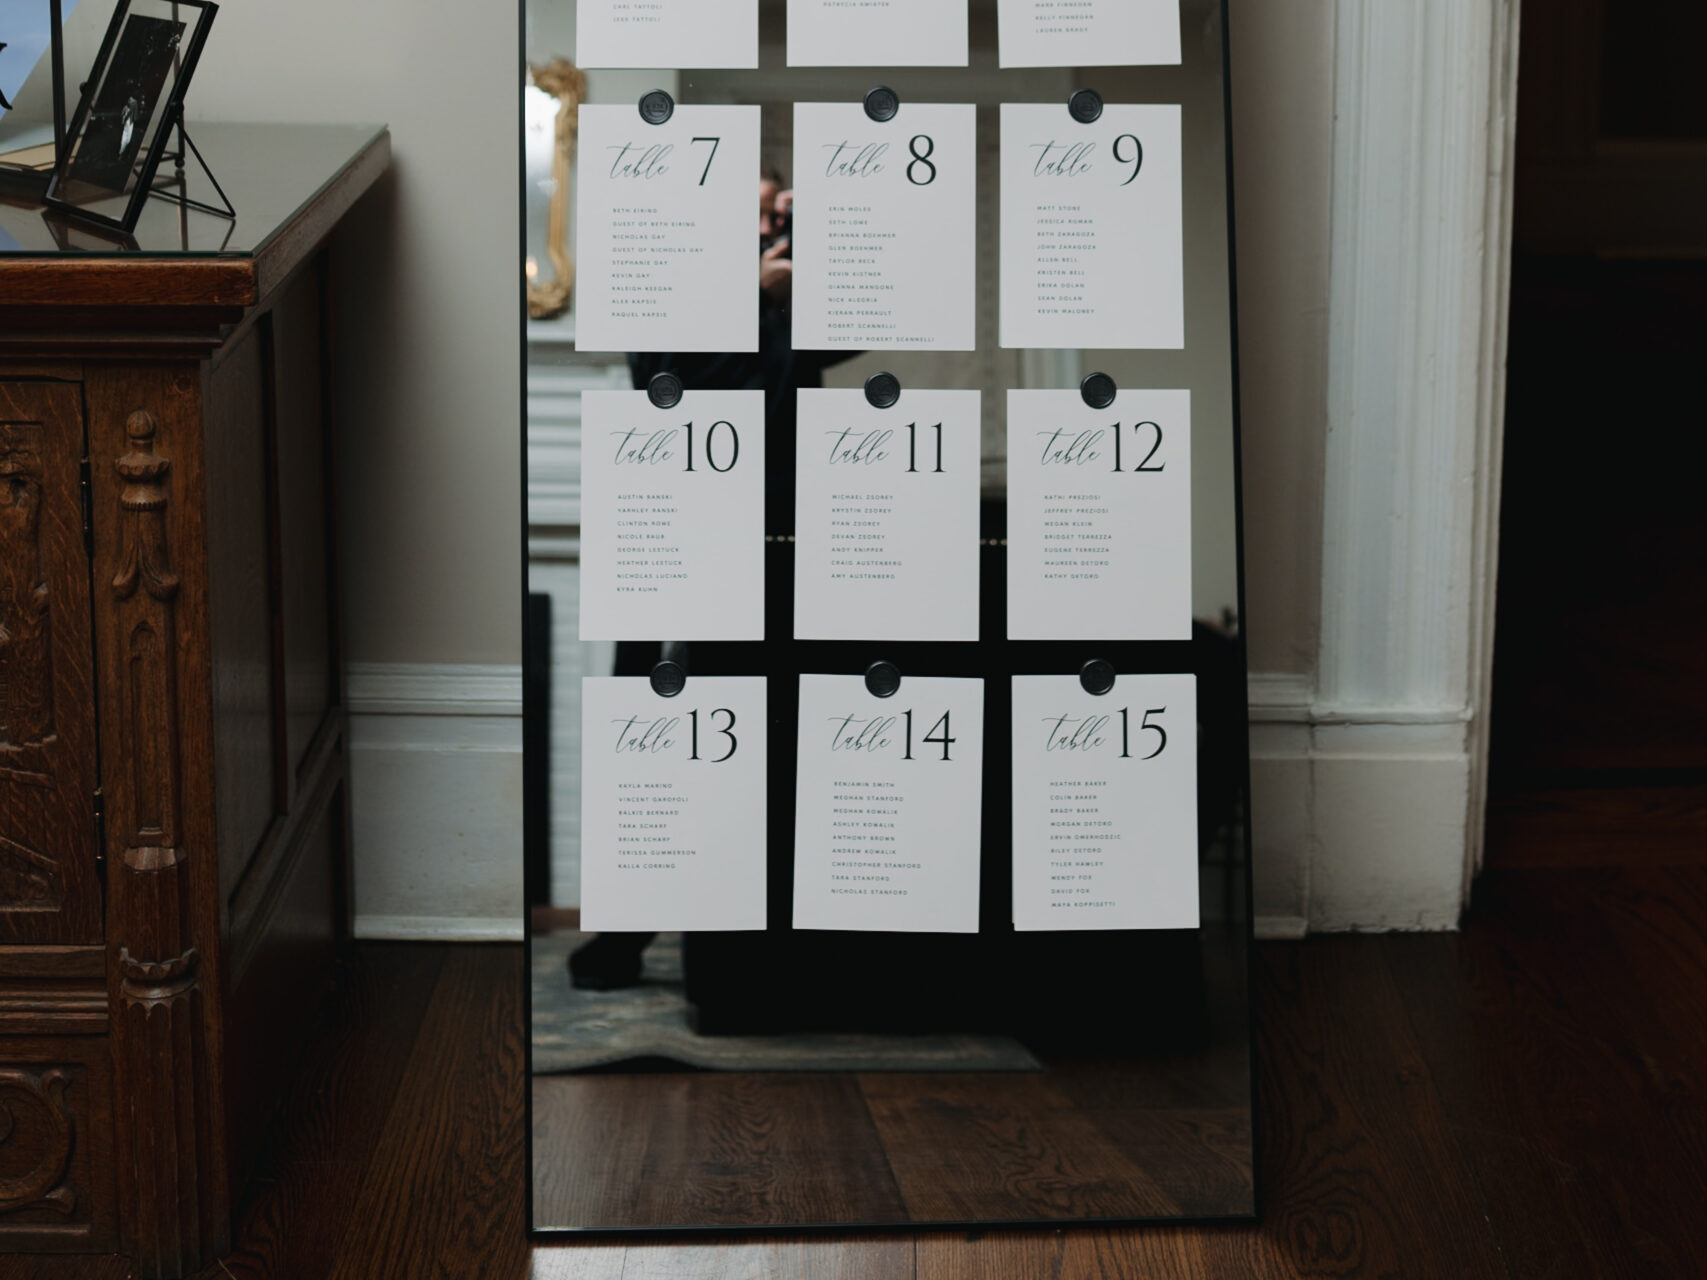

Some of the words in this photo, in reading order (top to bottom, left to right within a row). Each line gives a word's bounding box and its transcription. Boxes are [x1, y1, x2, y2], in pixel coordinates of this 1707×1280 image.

[606, 141, 674, 180] table
[691, 137, 720, 186] 7
[822, 140, 890, 178] table
[906, 135, 936, 186] 8
[1029, 140, 1096, 178] table
[1112, 134, 1143, 186] 9
[610, 424, 680, 465] table
[683, 421, 739, 472] 10
[824, 426, 894, 466] table
[905, 422, 946, 472] 11
[1036, 427, 1106, 466] table
[1111, 421, 1165, 472] 12
[610, 715, 680, 754] table
[687, 708, 737, 763] 13
[827, 713, 898, 752] table
[901, 709, 956, 761] 14
[1041, 712, 1111, 752] table
[1118, 706, 1167, 760] 15
